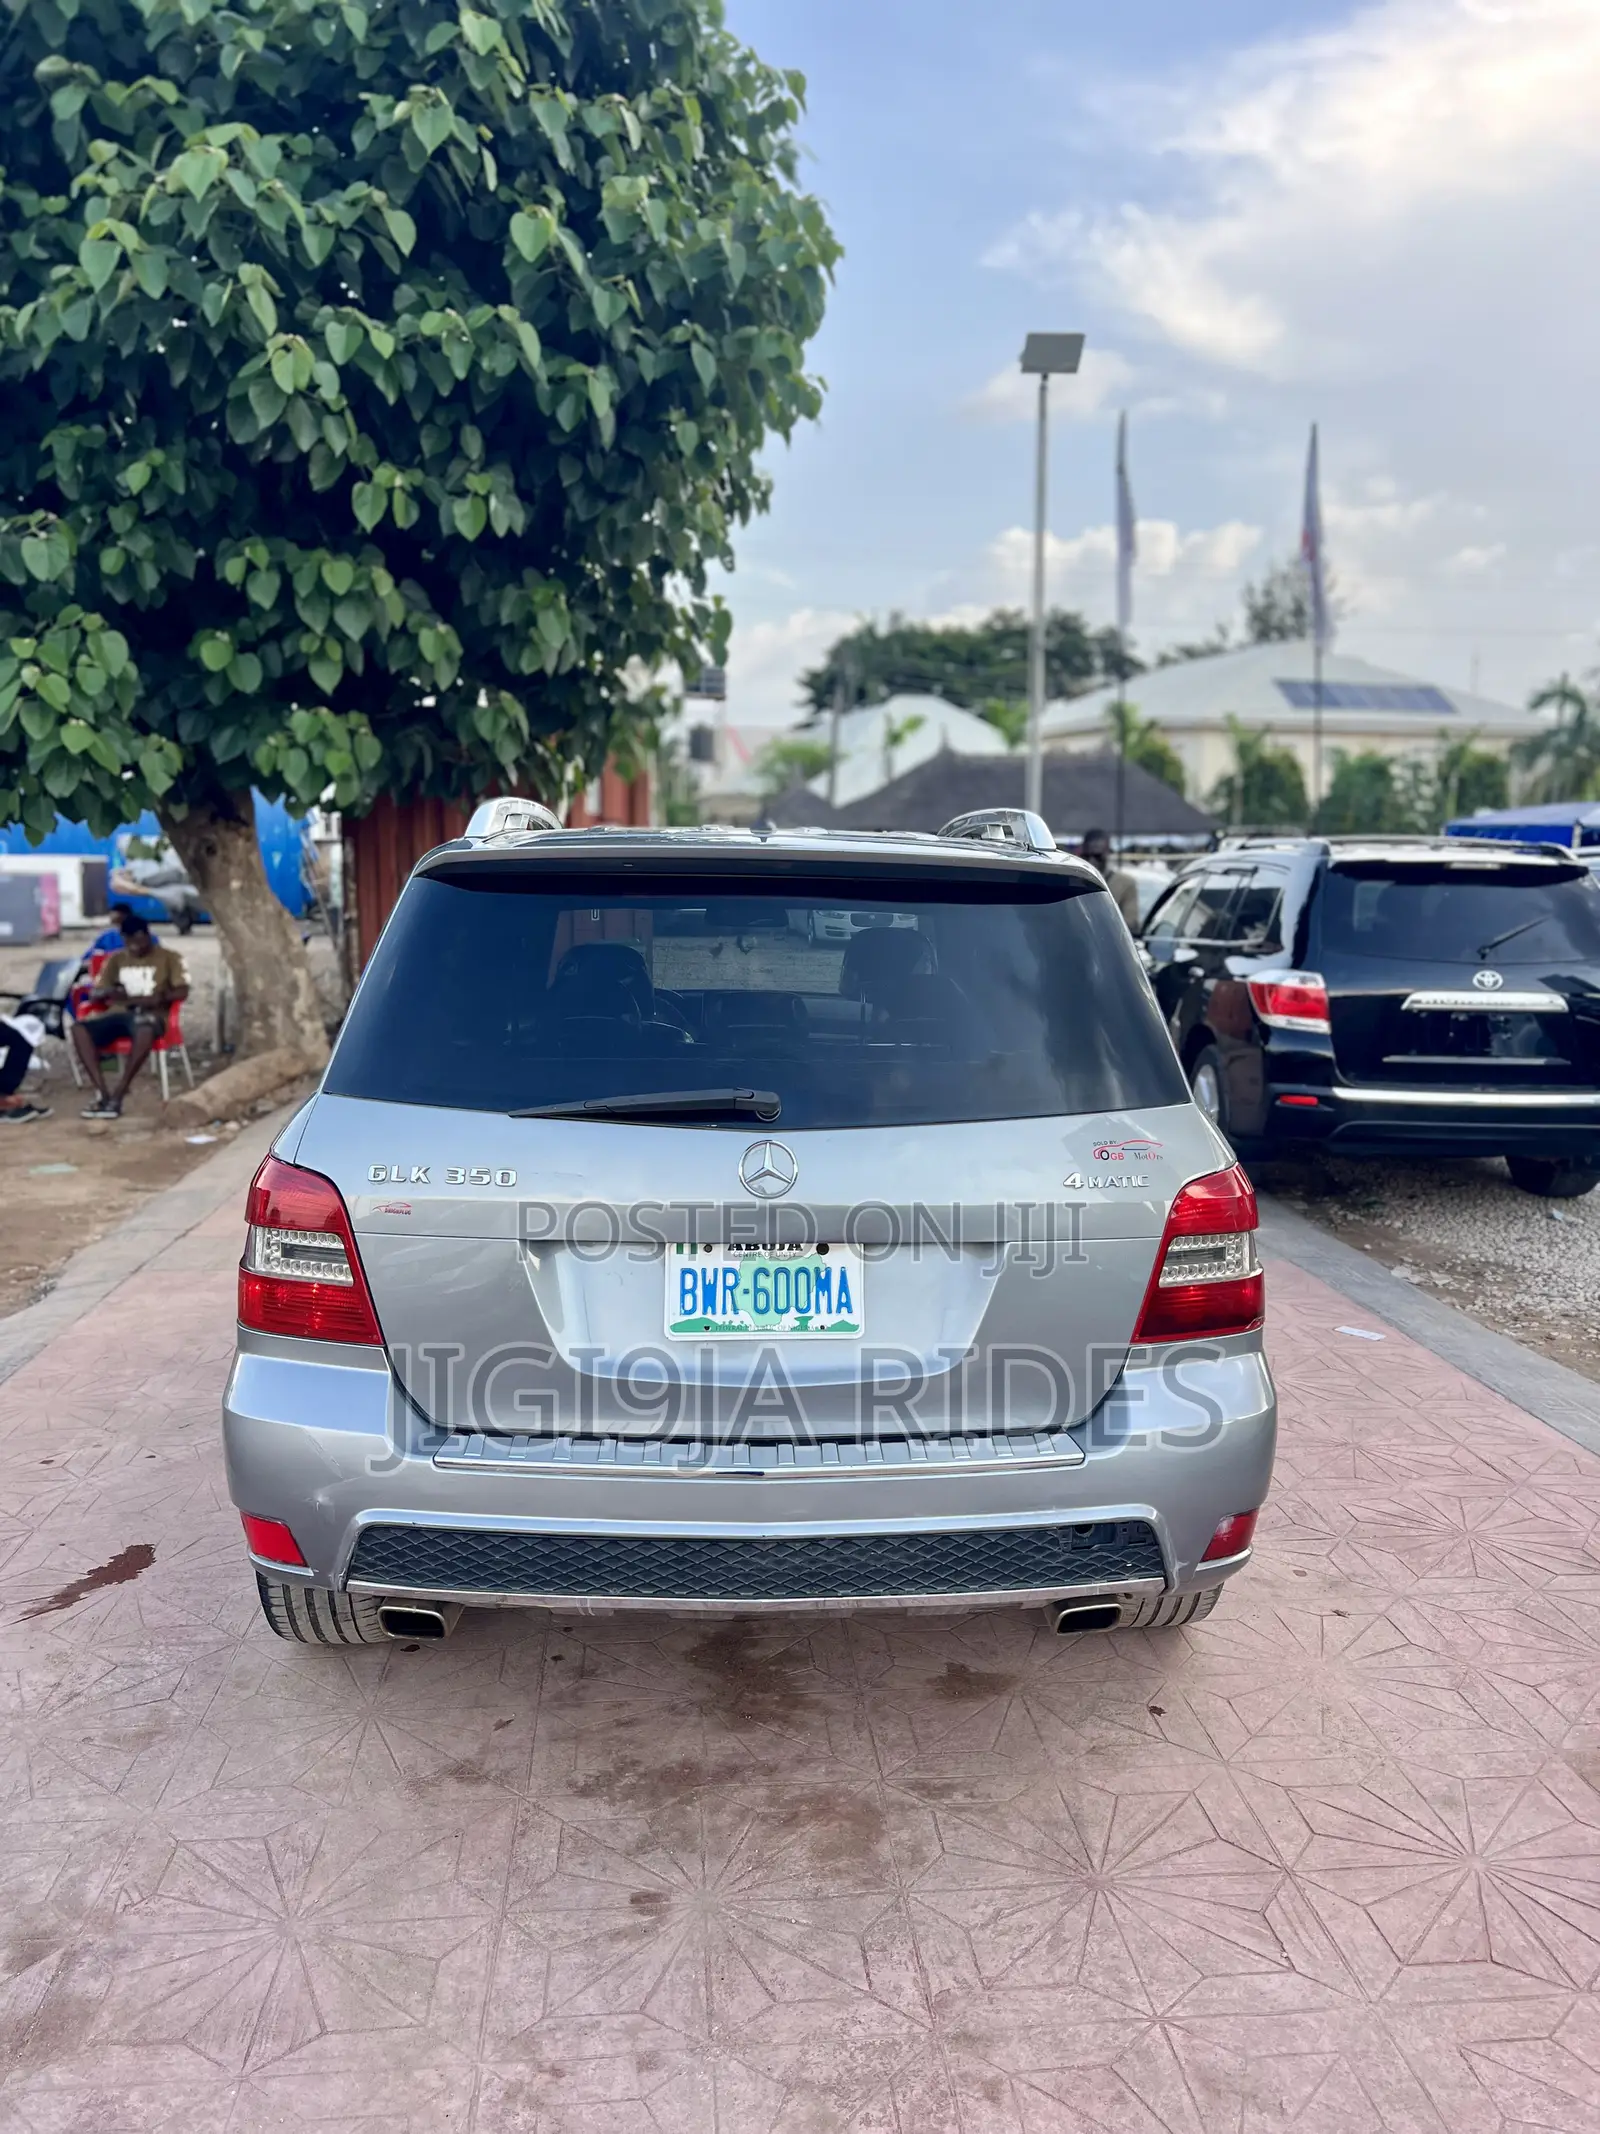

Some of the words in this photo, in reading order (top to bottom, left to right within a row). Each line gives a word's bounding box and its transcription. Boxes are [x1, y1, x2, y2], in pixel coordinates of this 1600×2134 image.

[368, 1164, 431, 1184] GLK
[445, 1166, 518, 1187] 350
[680, 1266, 853, 1316] BWR-600MA
